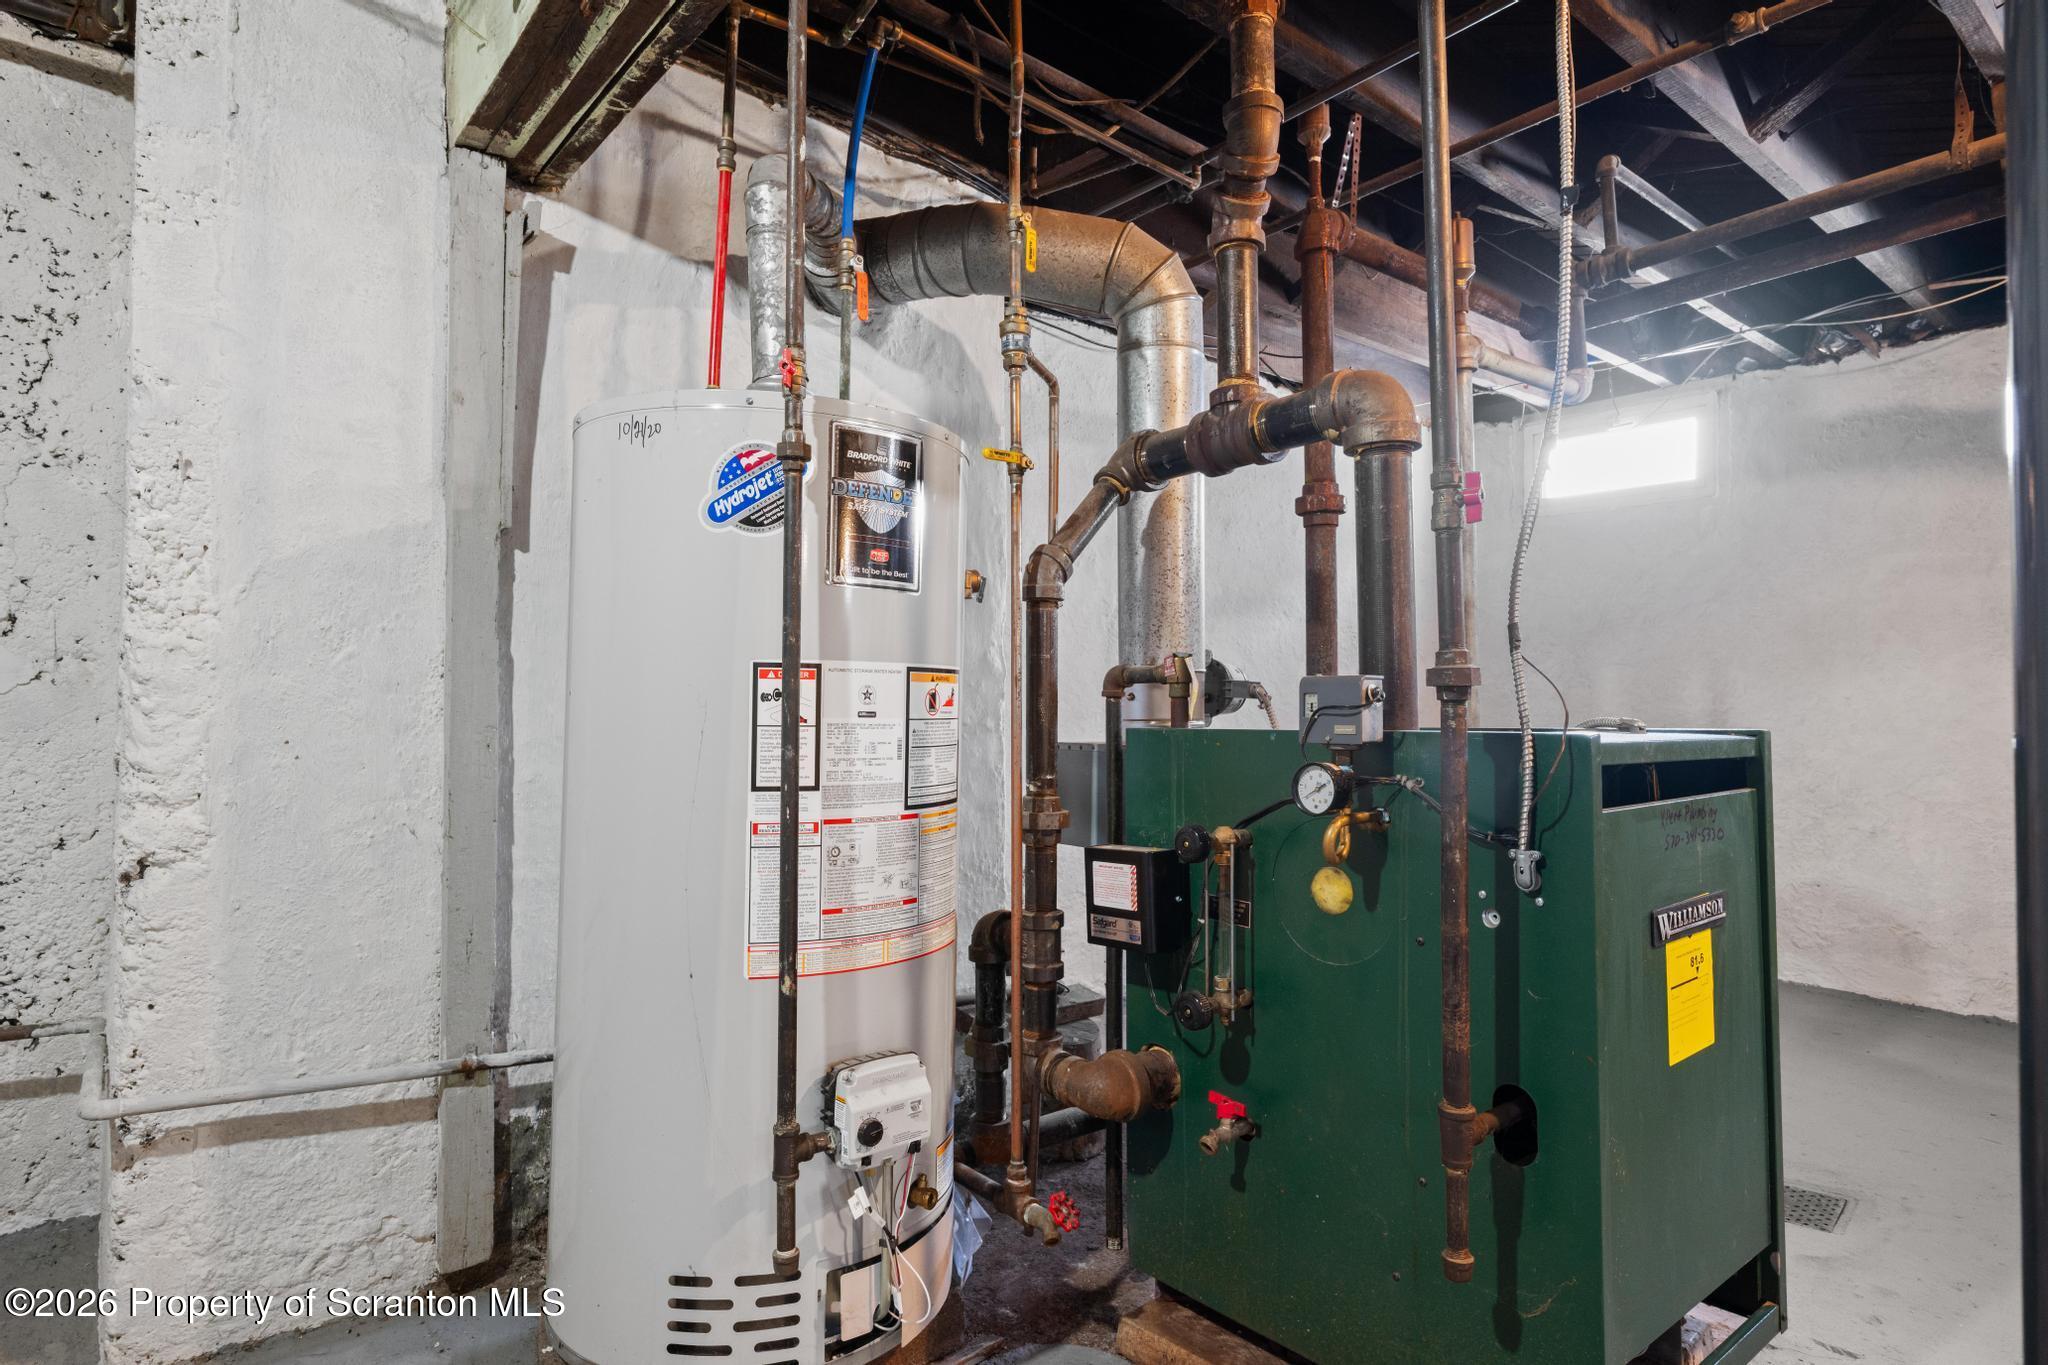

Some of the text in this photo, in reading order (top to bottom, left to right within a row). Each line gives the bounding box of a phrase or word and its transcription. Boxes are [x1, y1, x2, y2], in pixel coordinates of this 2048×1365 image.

[617, 414, 662, 448] 10/21/20
[846, 449, 888, 464] BRADFORD
[713, 470, 774, 518] Hydrojet
[832, 477, 917, 507] DEFENDE
[870, 567, 880, 576] be
[881, 569, 893, 577] the
[893, 569, 909, 578] Best
[1092, 916, 1117, 929] Safgard
[1657, 897, 1724, 941] WILLIAMSON
